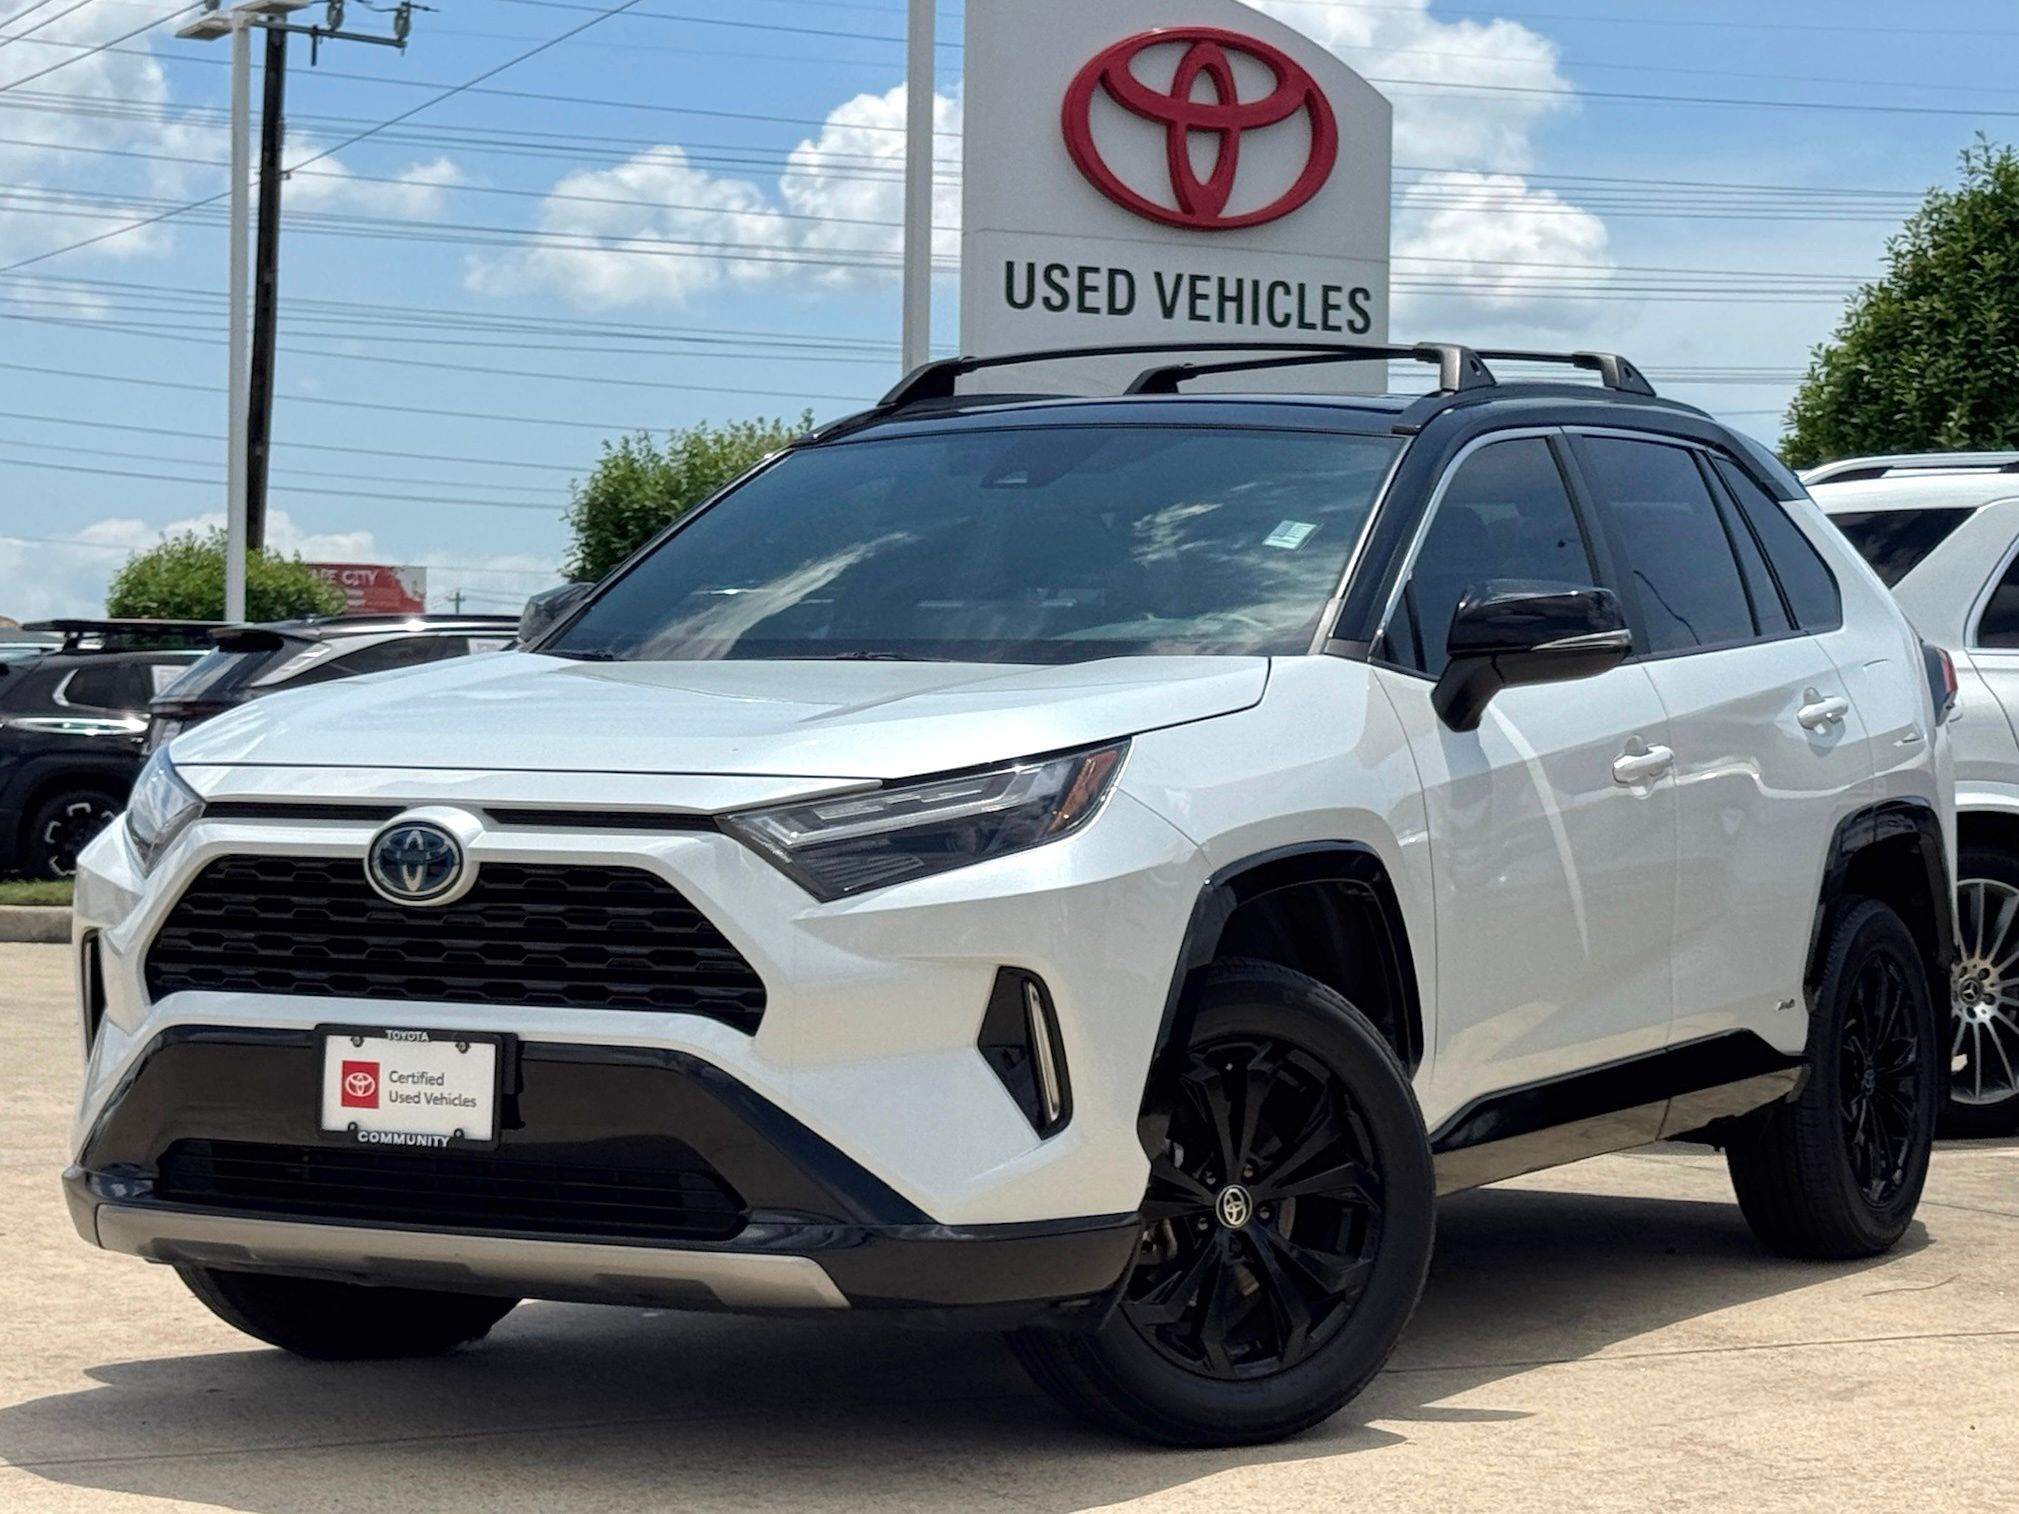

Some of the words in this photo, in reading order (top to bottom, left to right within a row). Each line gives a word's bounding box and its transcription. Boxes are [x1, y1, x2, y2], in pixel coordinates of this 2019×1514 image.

[1004, 260, 1137, 316] USED
[1153, 270, 1372, 335] VEHICLES
[341, 569, 378, 586] CITY
[385, 1029, 430, 1042] TOYOTA
[389, 1070, 445, 1086] Certified
[389, 1090, 421, 1105] Used
[424, 1092, 477, 1108] Vehicles
[357, 1131, 450, 1147] COMMUNITY
